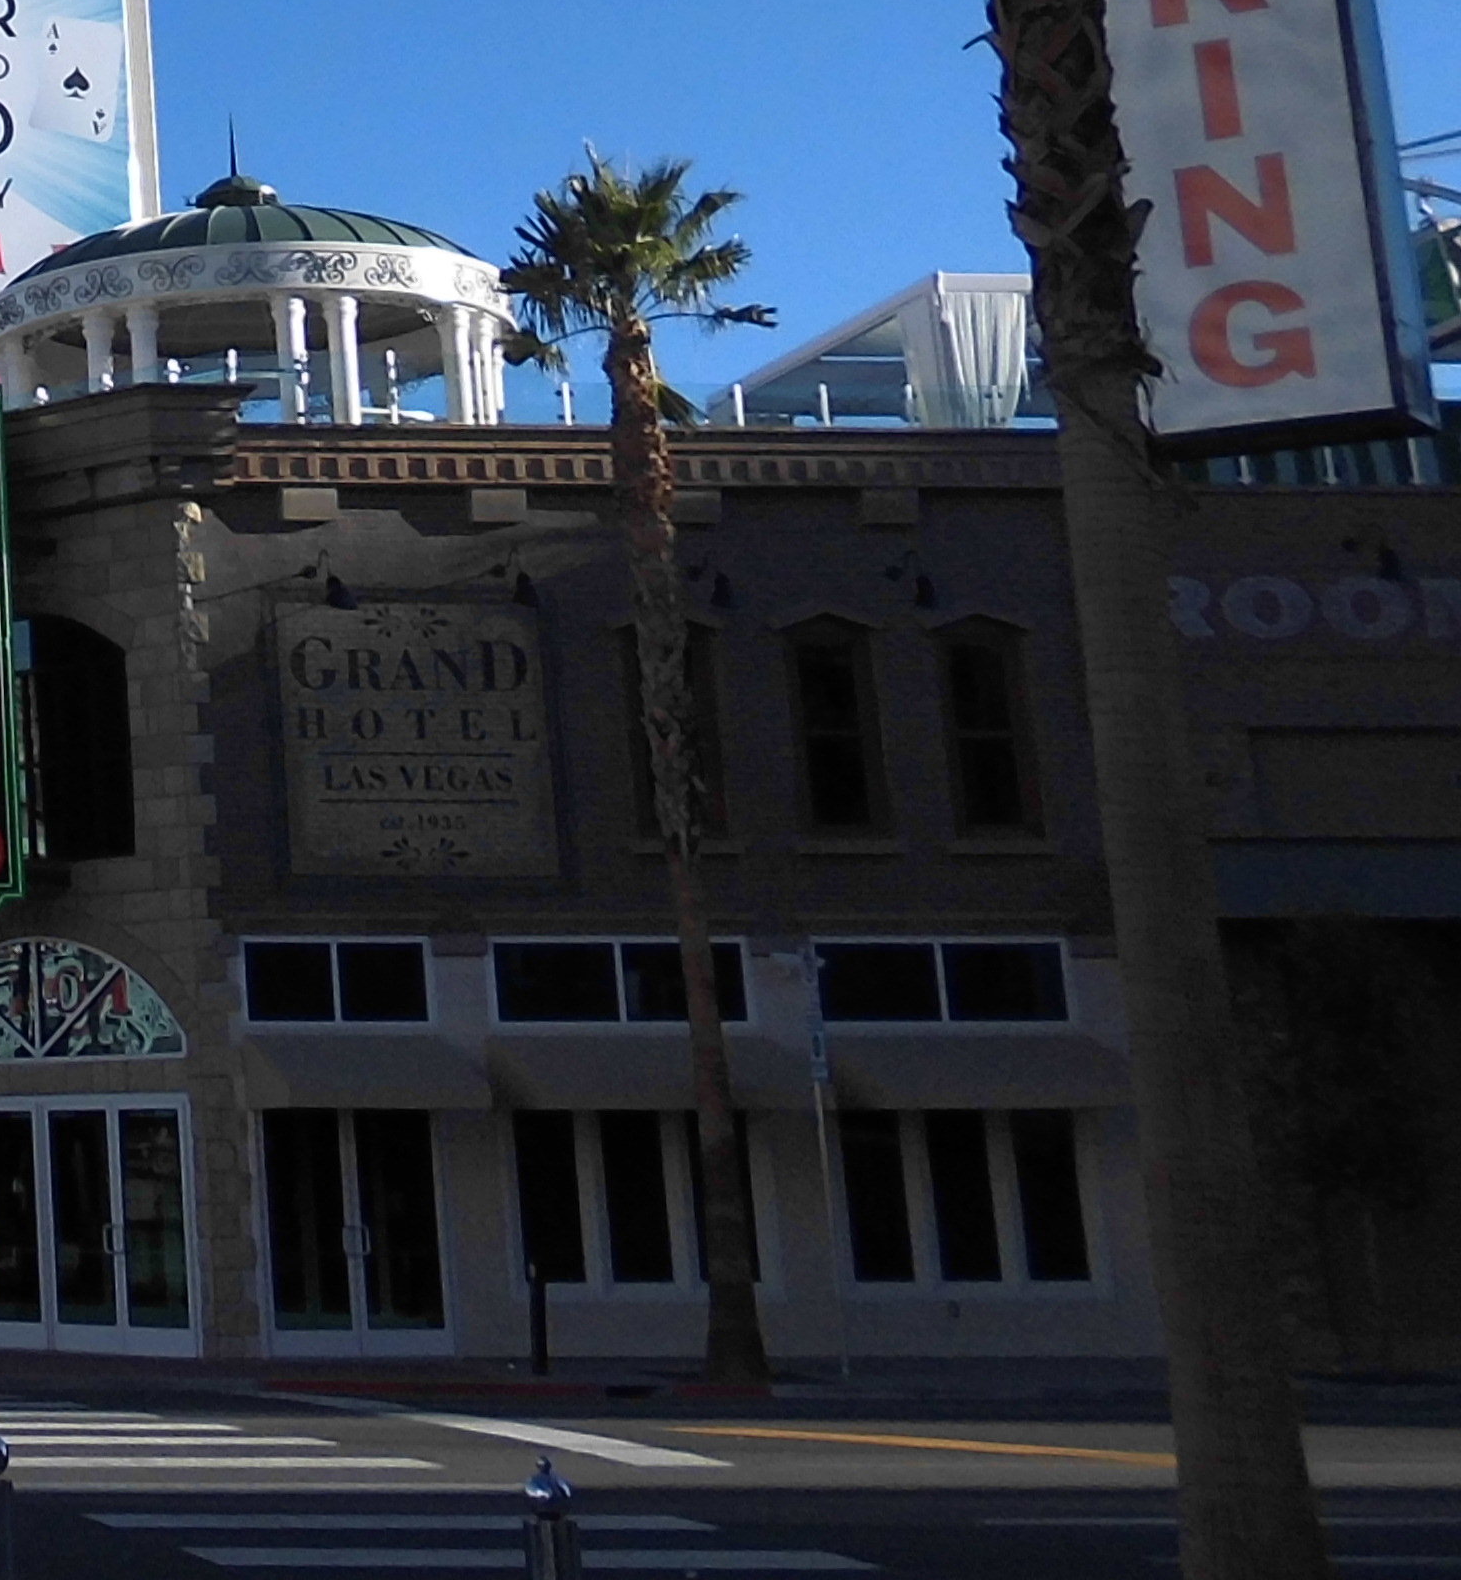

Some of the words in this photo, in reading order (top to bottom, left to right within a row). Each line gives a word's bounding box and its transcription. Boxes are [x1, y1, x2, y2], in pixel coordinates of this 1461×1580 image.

[289, 635, 527, 691] GRAND
[296, 707, 537, 741] HOTEL
[324, 765, 388, 791] LAS
[399, 765, 513, 791] VEGAS
